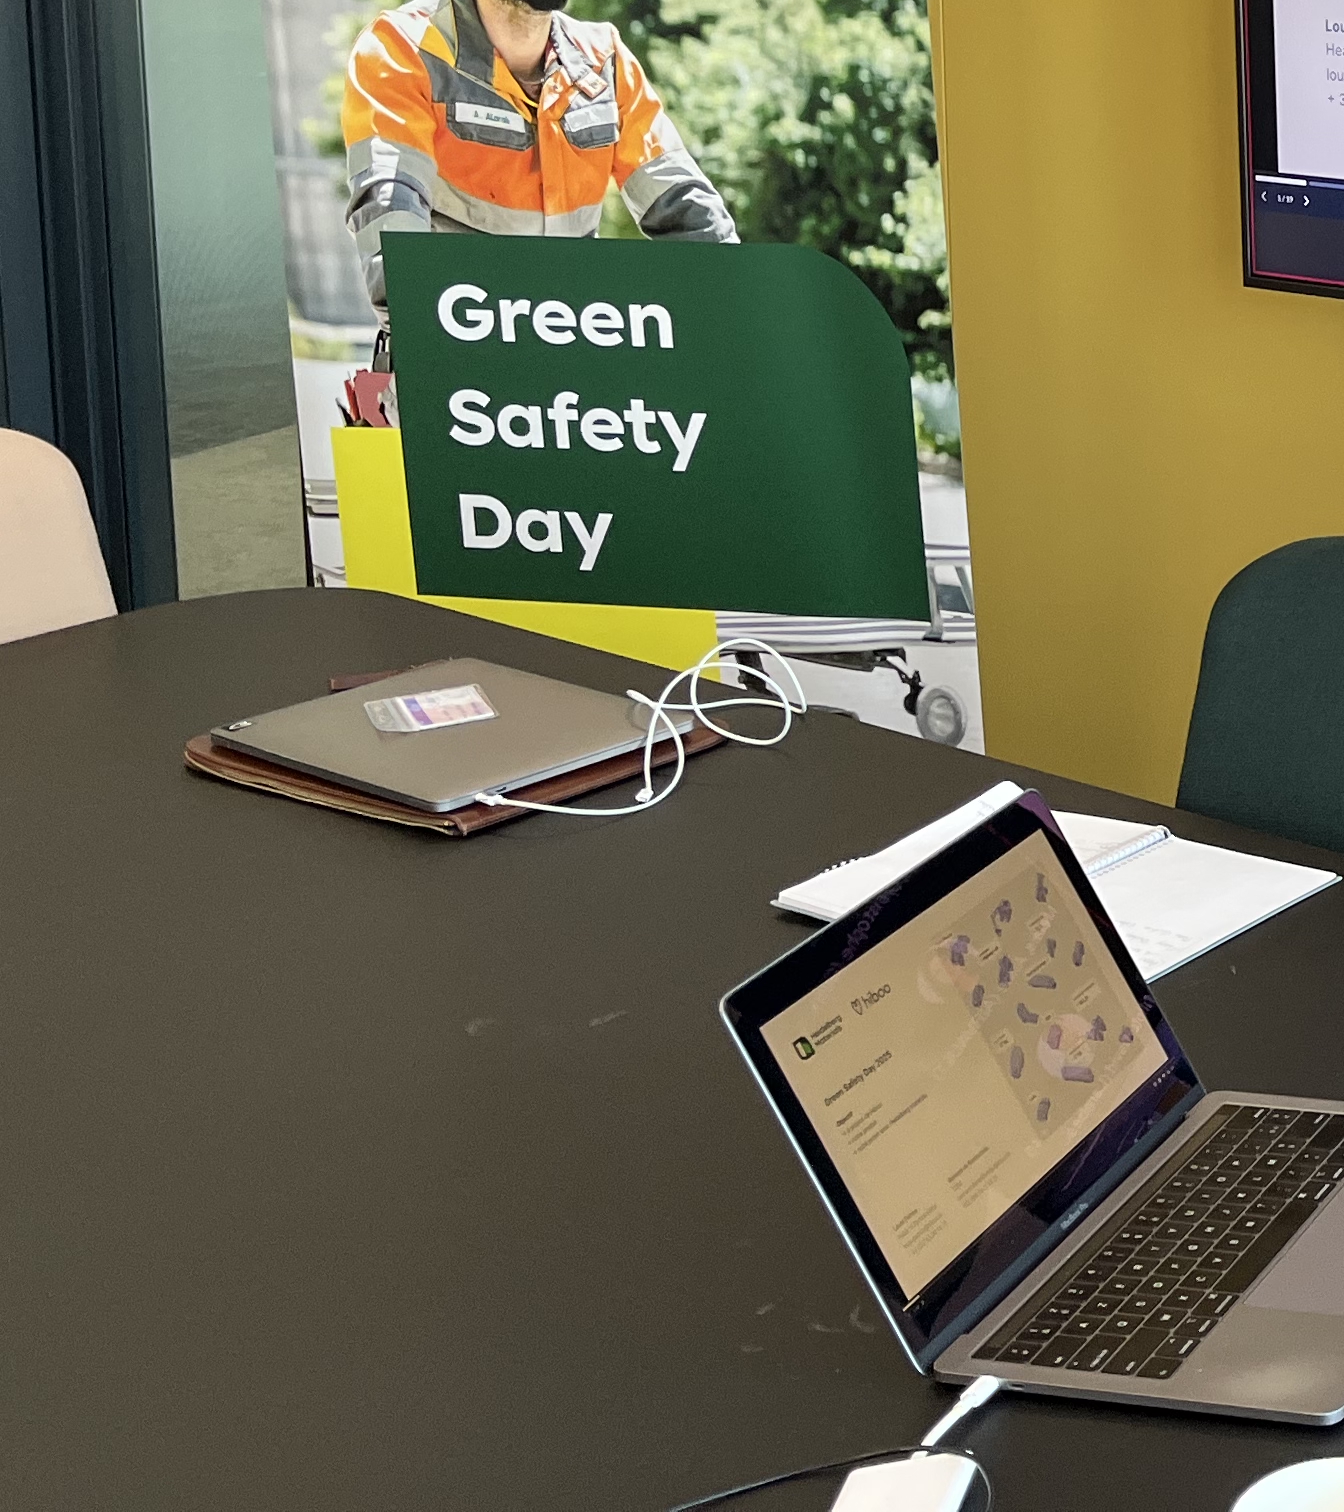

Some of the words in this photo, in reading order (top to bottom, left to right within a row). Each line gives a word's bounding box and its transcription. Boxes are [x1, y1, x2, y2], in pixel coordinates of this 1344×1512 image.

[437, 283, 674, 350] Green
[448, 389, 707, 473] Safety
[458, 493, 614, 572] Day
